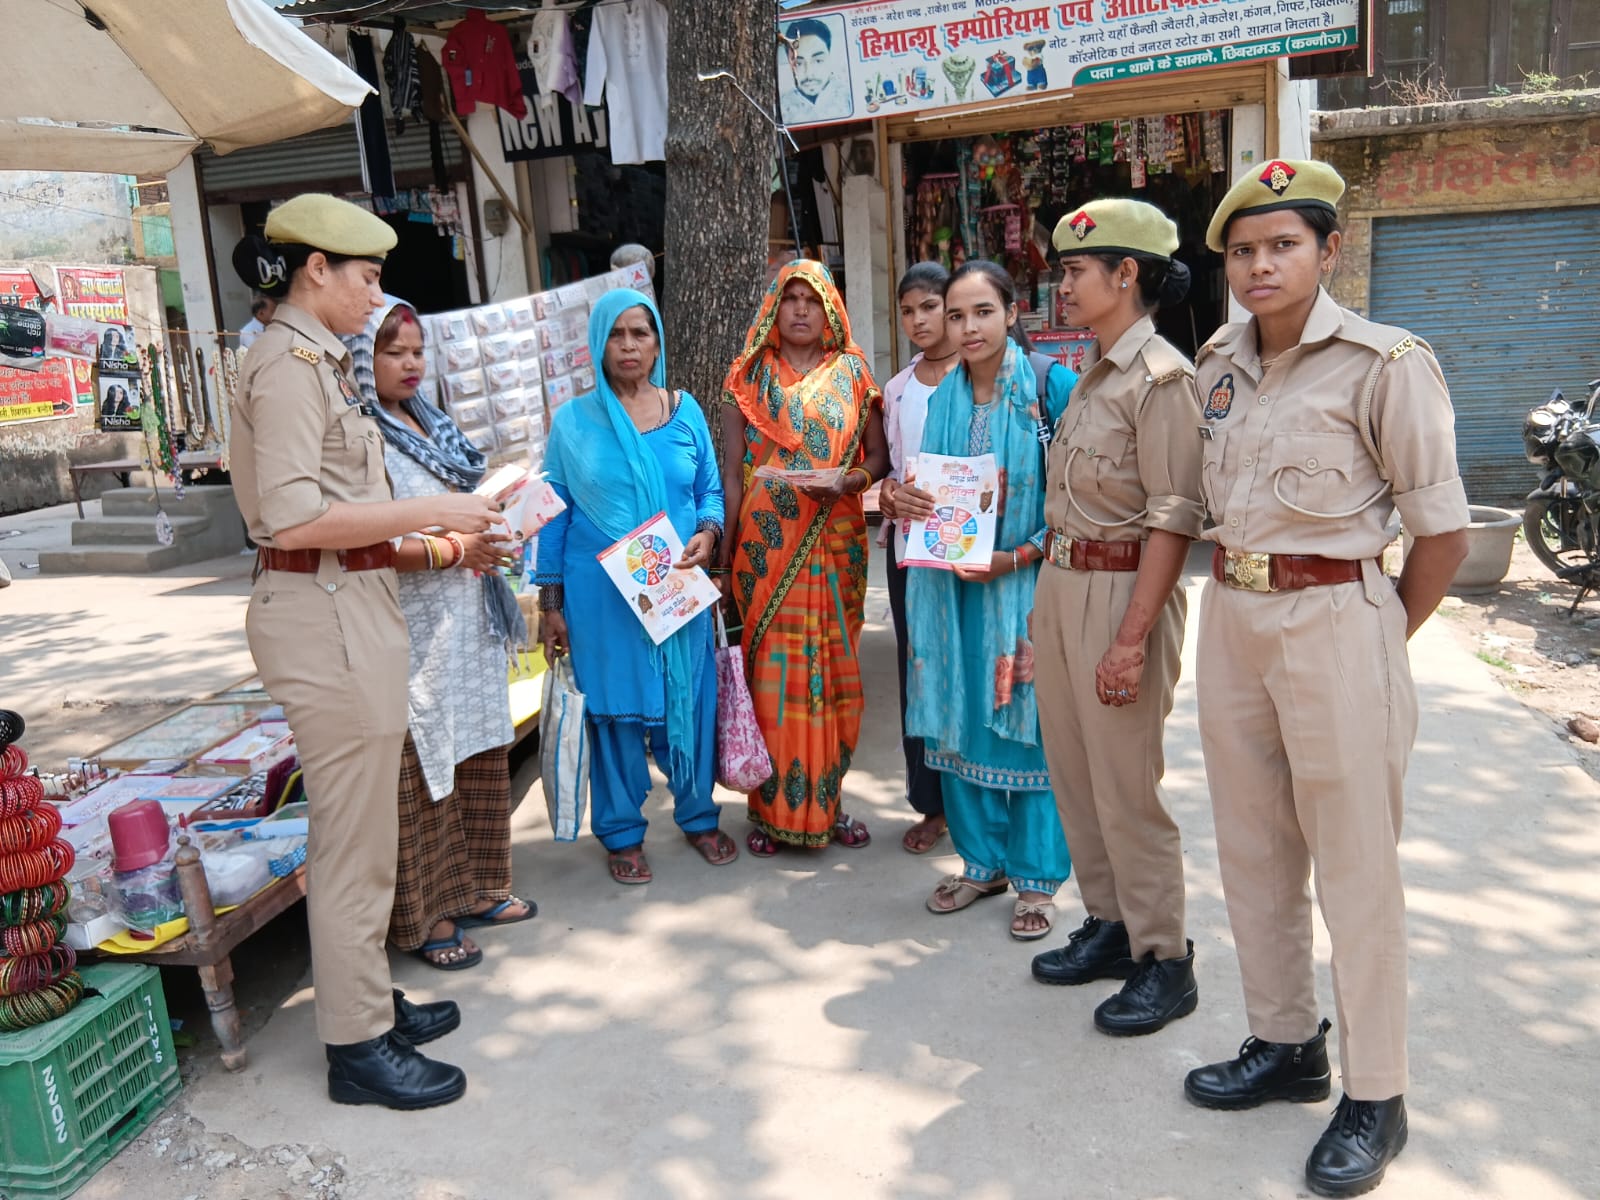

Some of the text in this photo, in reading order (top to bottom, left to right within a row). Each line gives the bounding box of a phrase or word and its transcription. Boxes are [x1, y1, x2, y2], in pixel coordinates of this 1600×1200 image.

[944, 6, 1050, 48] इम्पोरियम
[1049, 35, 1067, 49] नोट
[1079, 28, 1105, 46] हमारे
[1130, 20, 1158, 36] फैन्सी
[1121, 42, 1135, 57] एवं
[1138, 39, 1171, 54] जनरल
[1175, 32, 1198, 47] स्टोर
[1201, 33, 1215, 43] का
[1218, 25, 1241, 41] सभी
[1247, 22, 1282, 37] सामान
[1285, 17, 1320, 31] मिलता
[1089, 66, 1114, 80] पता
[1128, 57, 1154, 74] थाने
[1156, 55, 1172, 70] के
[144, 995, 163, 1064] SAHIL
